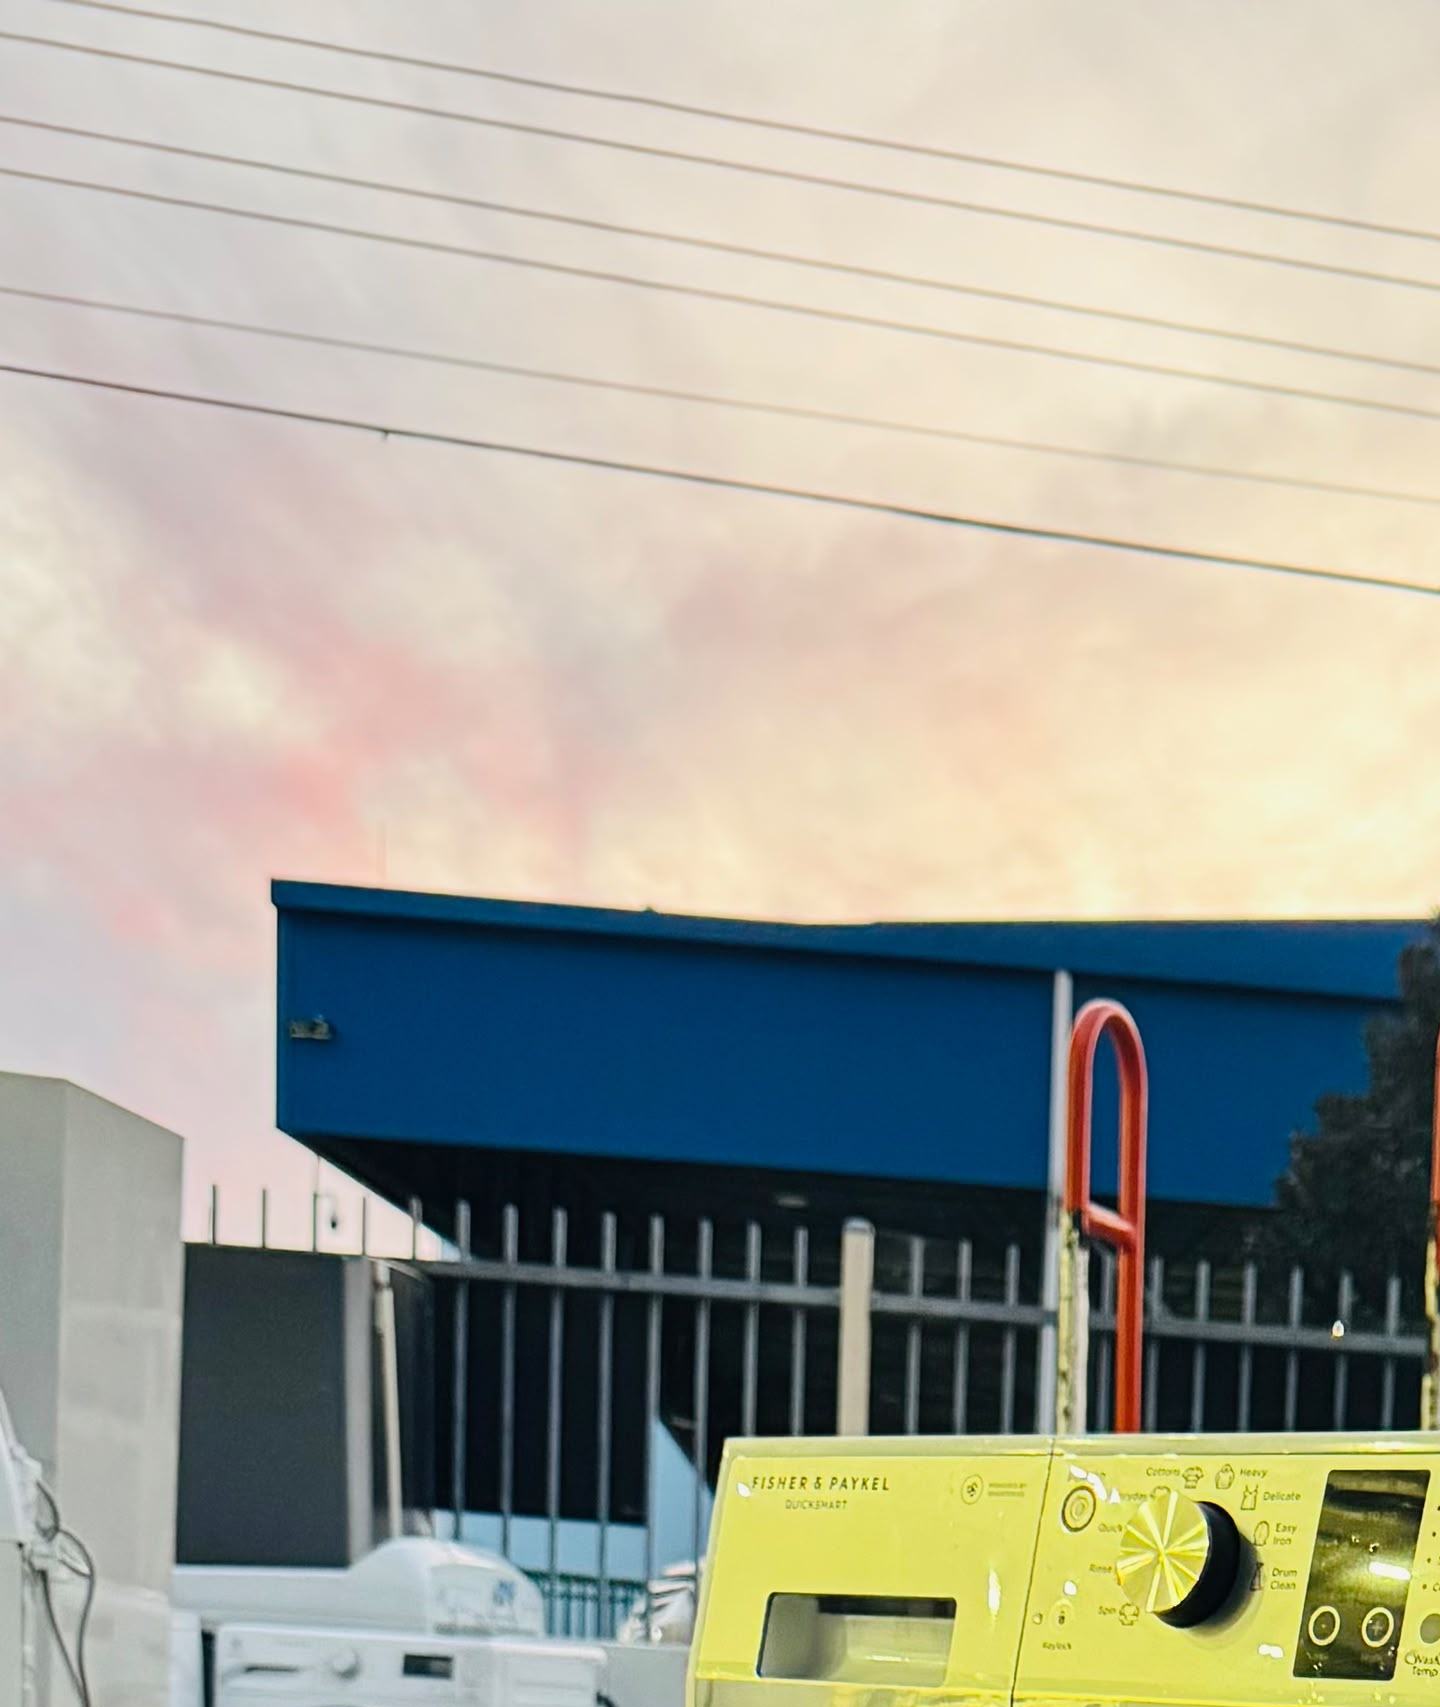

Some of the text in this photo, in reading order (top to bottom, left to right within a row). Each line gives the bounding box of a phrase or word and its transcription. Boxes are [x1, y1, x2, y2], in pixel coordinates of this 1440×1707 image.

[1240, 1468, 1268, 1478] Heavy
[752, 1476, 890, 1491] FISHER & PAYKEL
[1263, 1491, 1302, 1501] Delicate
[1275, 1523, 1298, 1534] Easy
[1272, 1537, 1292, 1546] Iron
[1272, 1567, 1298, 1577] Drum
[1270, 1580, 1296, 1590] Clean
